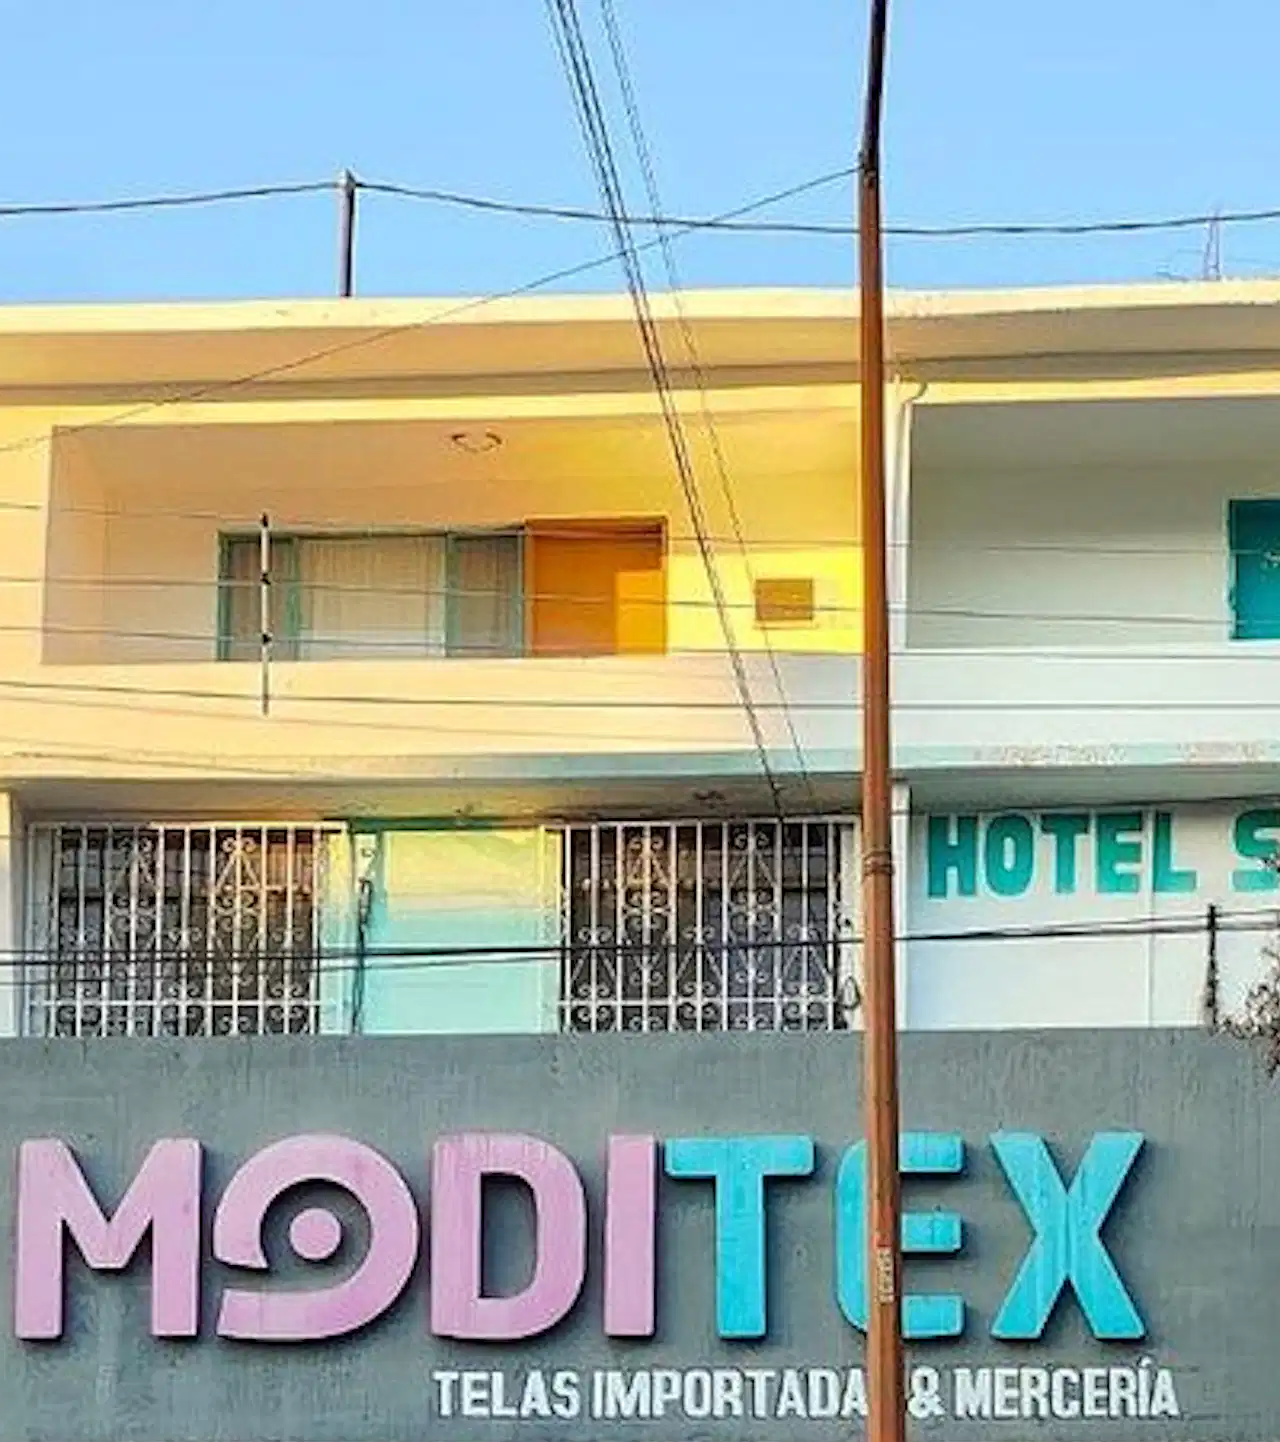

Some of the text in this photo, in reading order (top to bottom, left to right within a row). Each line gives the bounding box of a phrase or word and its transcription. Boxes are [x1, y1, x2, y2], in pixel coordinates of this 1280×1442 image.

[927, 813, 1197, 897] HOTEL
[15, 1131, 1146, 1340] MODITEX
[433, 1356, 1180, 1418] TELAS IMPORTADA & MERCERÍA
